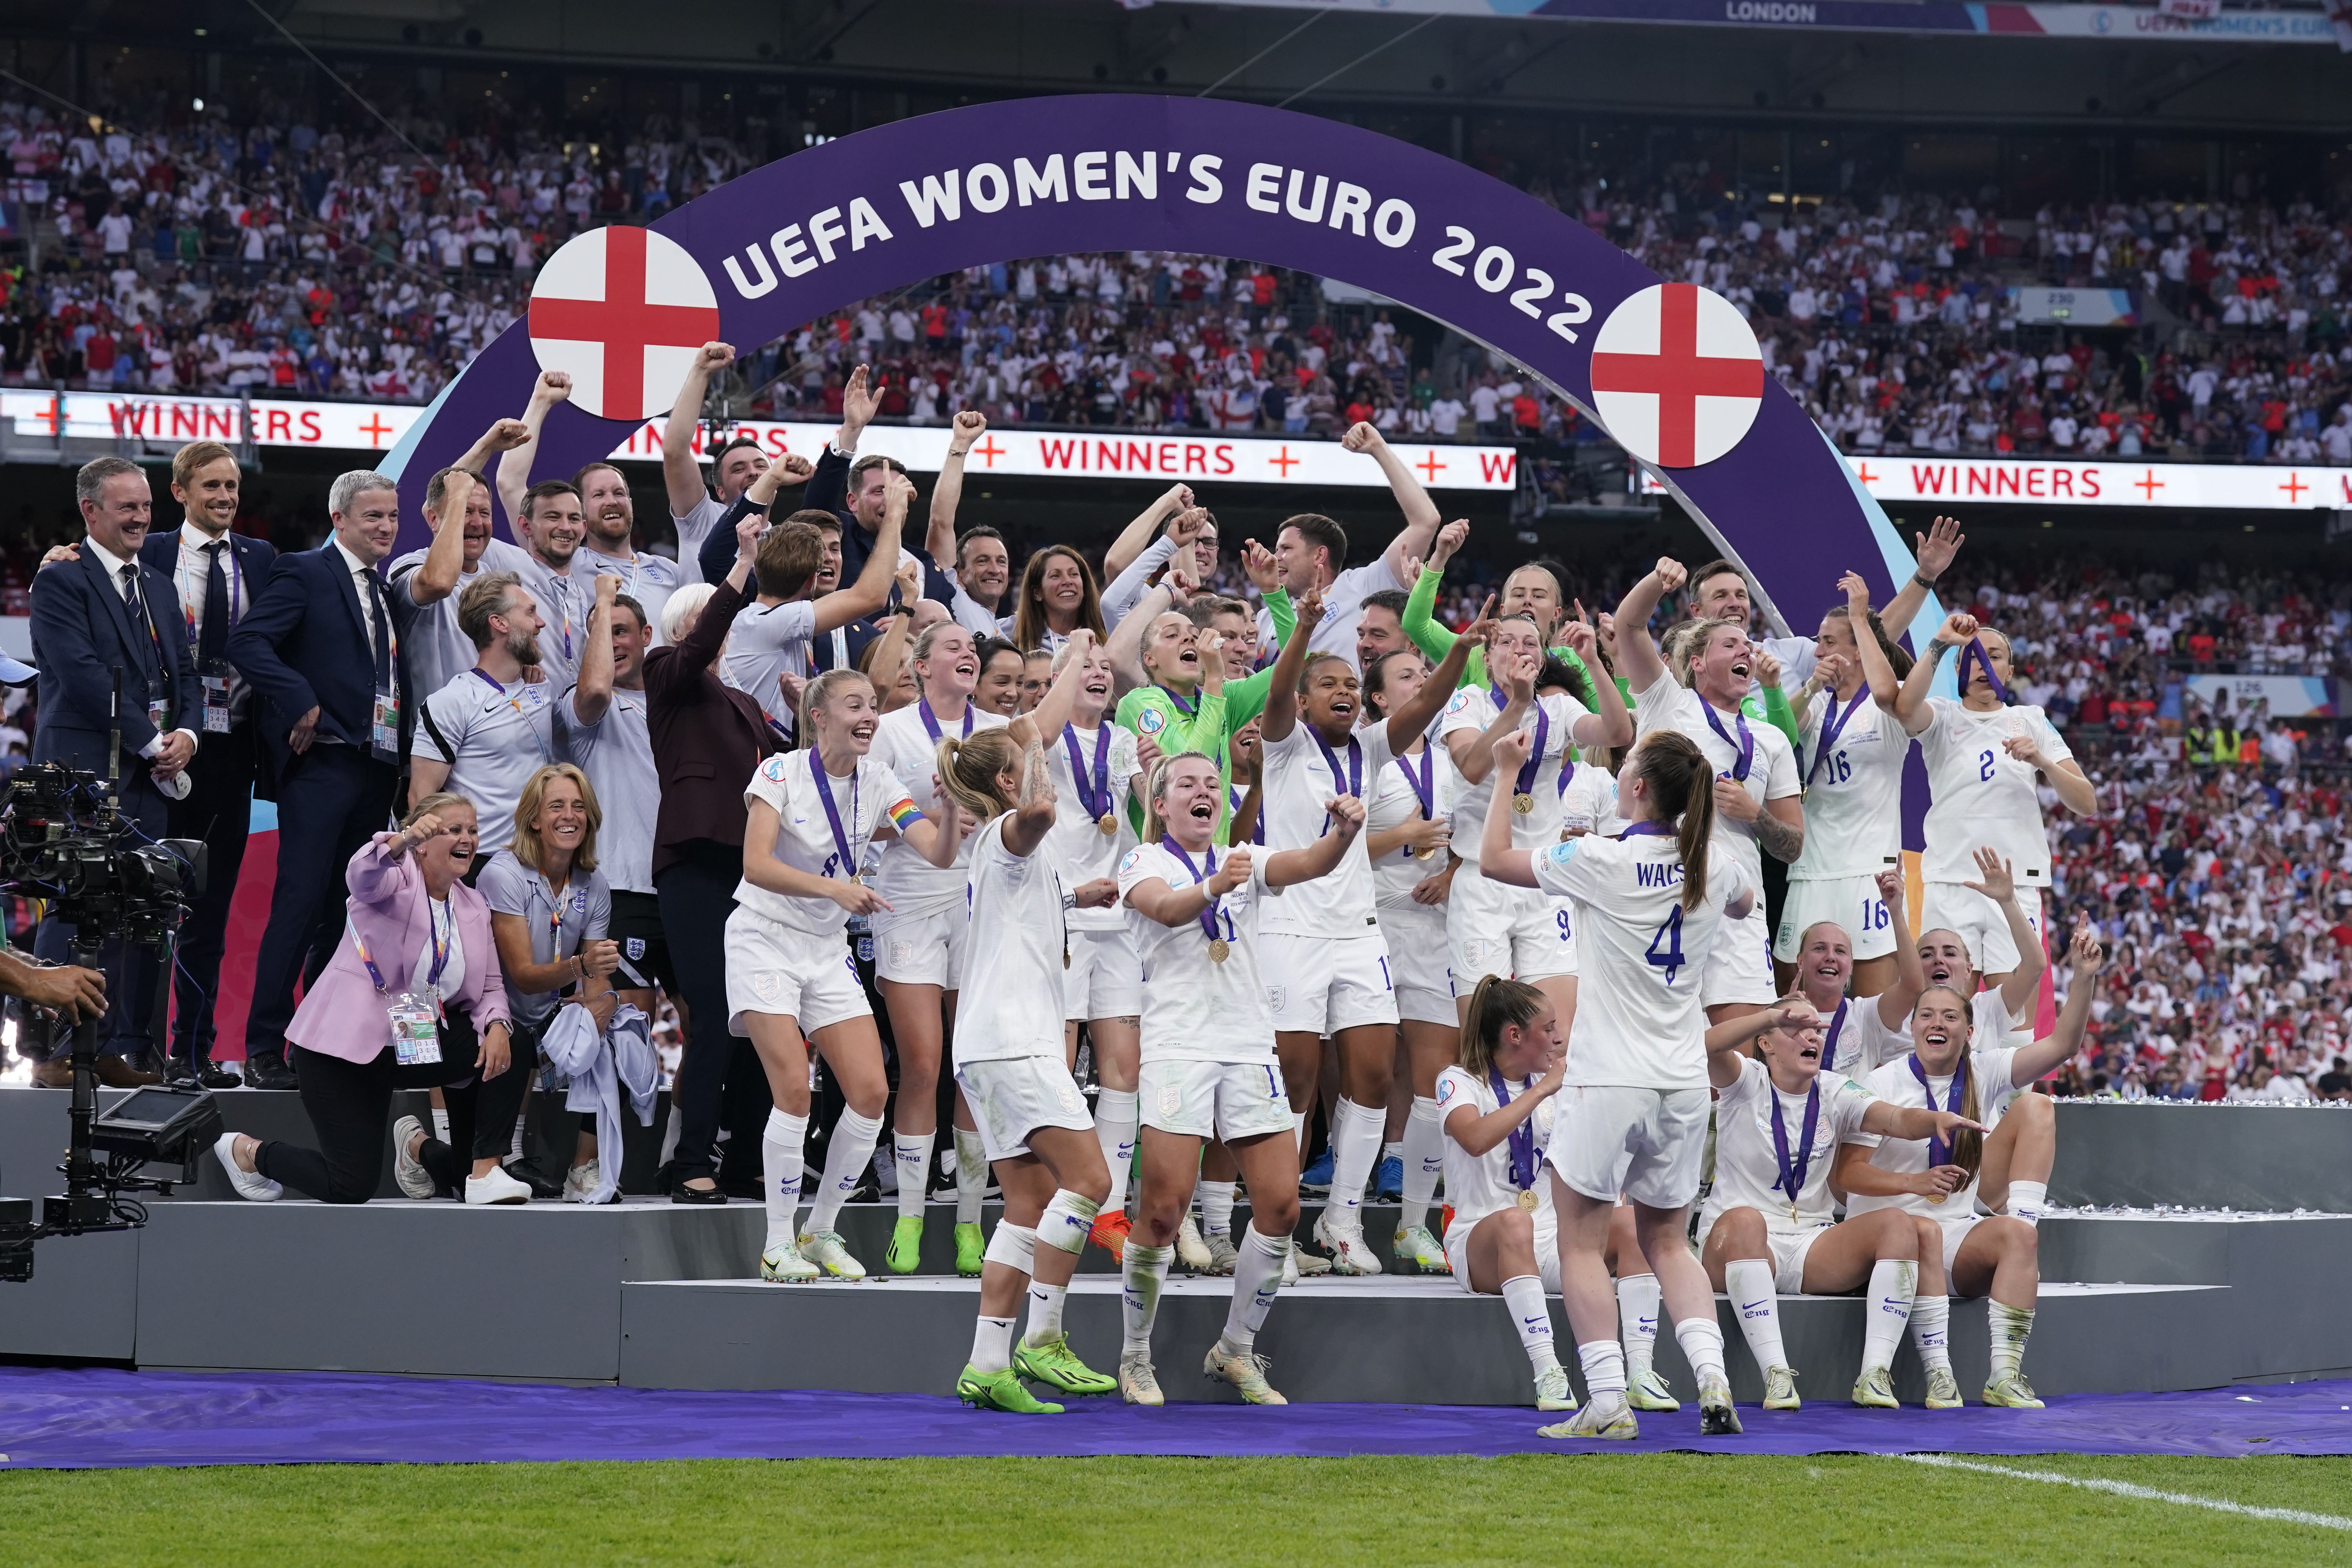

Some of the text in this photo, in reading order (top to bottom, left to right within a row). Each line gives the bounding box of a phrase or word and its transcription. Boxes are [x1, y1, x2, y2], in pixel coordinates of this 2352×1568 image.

[1726, 1, 1816, 24] LONDON
[2290, 16, 2336, 36] EUR
[722, 150, 1593, 345] UEFA WOMEN'S EURO 2022
[108, 403, 322, 442] WINNERS
[1040, 439, 1234, 474] WINNERS
[1912, 465, 2102, 498] WINNERS
[1824, 750, 1851, 785] 16
[1980, 750, 1995, 782] 2
[821, 852, 839, 878] 8
[1637, 862, 1686, 887] WALS
[548, 888, 556, 904] ENGLAND
[1557, 910, 1569, 942] 9
[1862, 898, 1889, 931] 16
[1645, 903, 1686, 986] 4
[1378, 955, 1392, 991] 1
[897, 1152, 921, 1162] Eng
[839, 1183, 855, 1191] En
[1125, 1296, 1144, 1310] Eng
[1744, 1309, 1769, 1319] Eng
[1883, 1305, 1907, 1318] Eng
[1640, 1326, 1656, 1335] Eng
